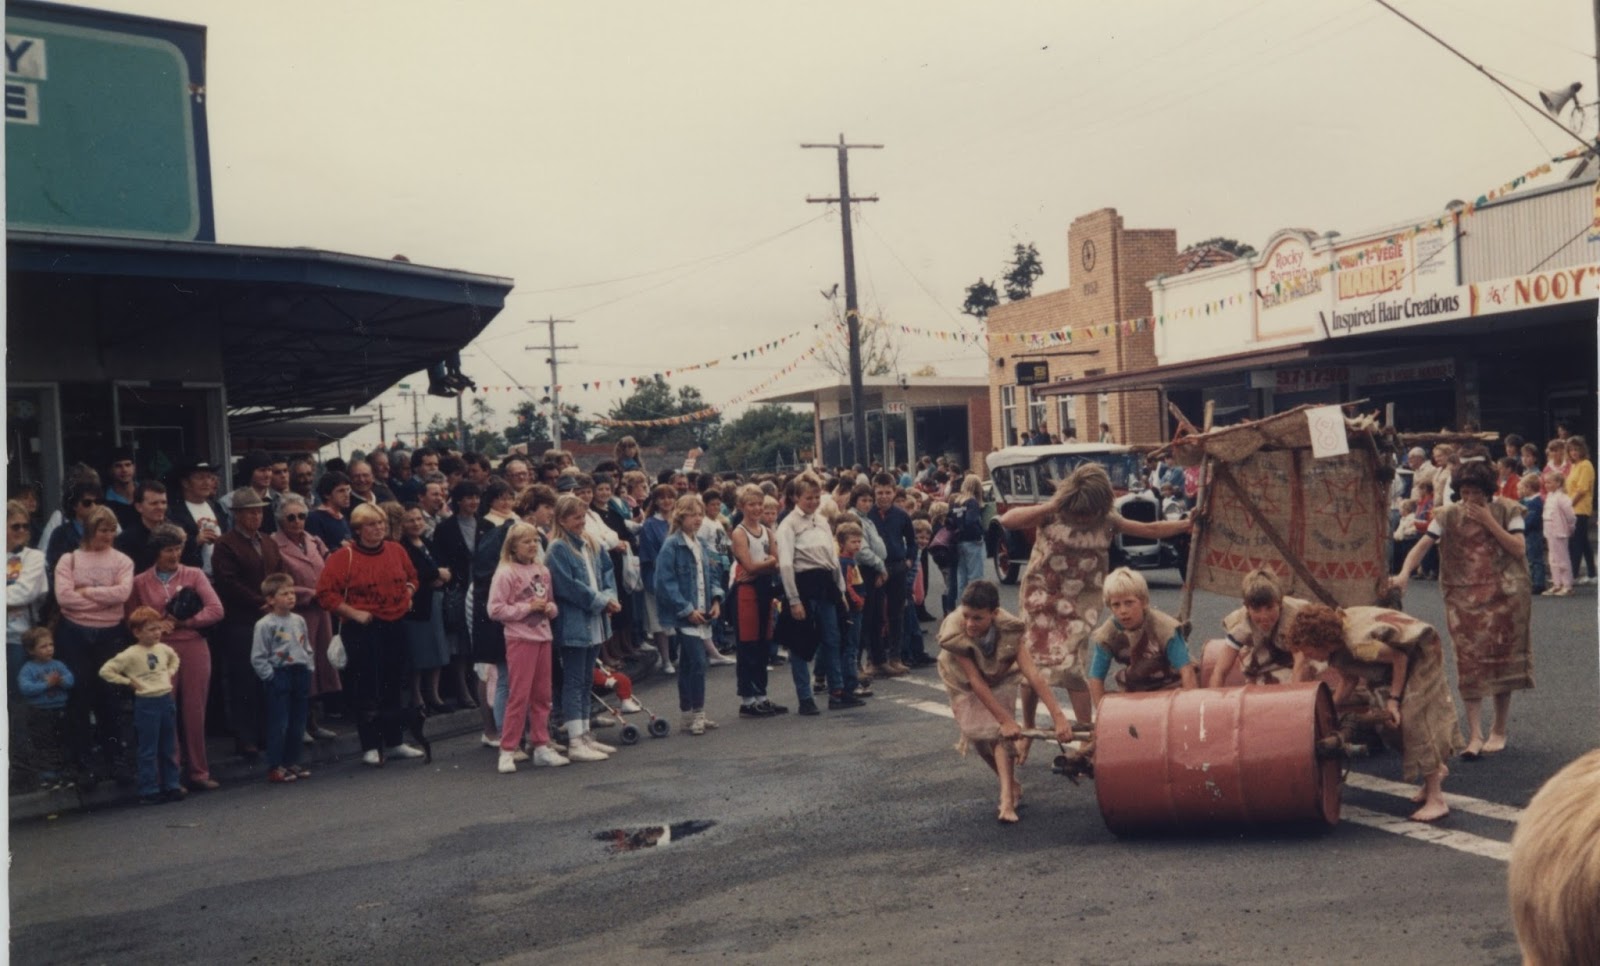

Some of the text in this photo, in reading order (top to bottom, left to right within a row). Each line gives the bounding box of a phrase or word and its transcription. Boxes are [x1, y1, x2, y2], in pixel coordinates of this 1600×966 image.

[1275, 249, 1304, 270] Rocky
[1377, 244, 1403, 262] VEGIE
[1339, 260, 1406, 301] MARKET
[1332, 303, 1376, 333] Inspired
[1378, 299, 1403, 324] Hair
[1404, 293, 1460, 319] Creations
